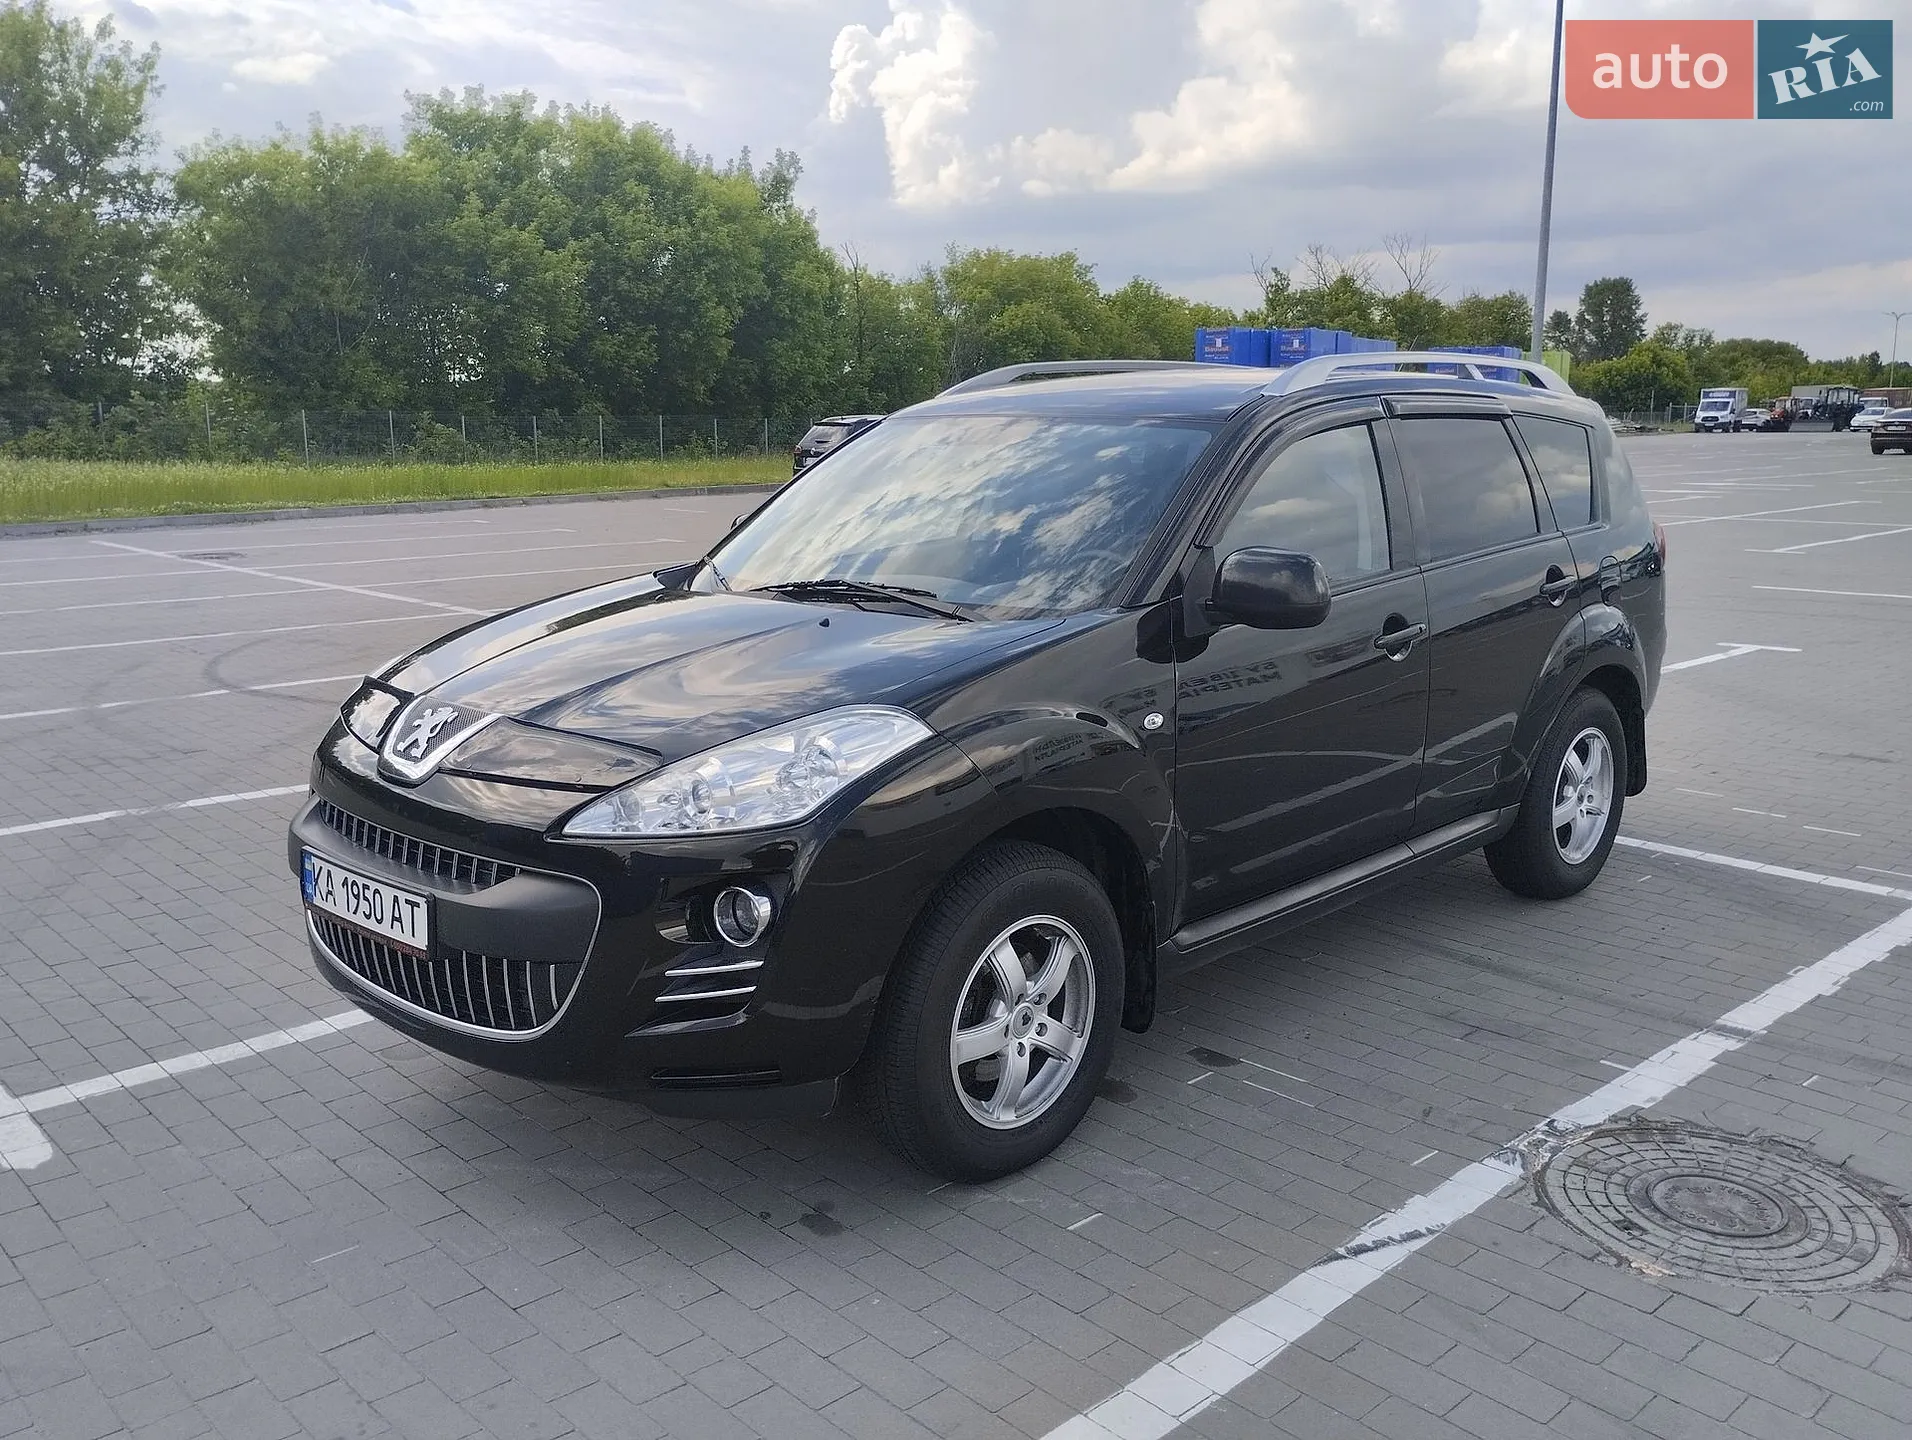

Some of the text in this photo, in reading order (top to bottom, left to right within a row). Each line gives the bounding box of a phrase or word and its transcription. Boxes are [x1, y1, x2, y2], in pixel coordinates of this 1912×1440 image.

[312, 862, 421, 938] KA 1950 AT
